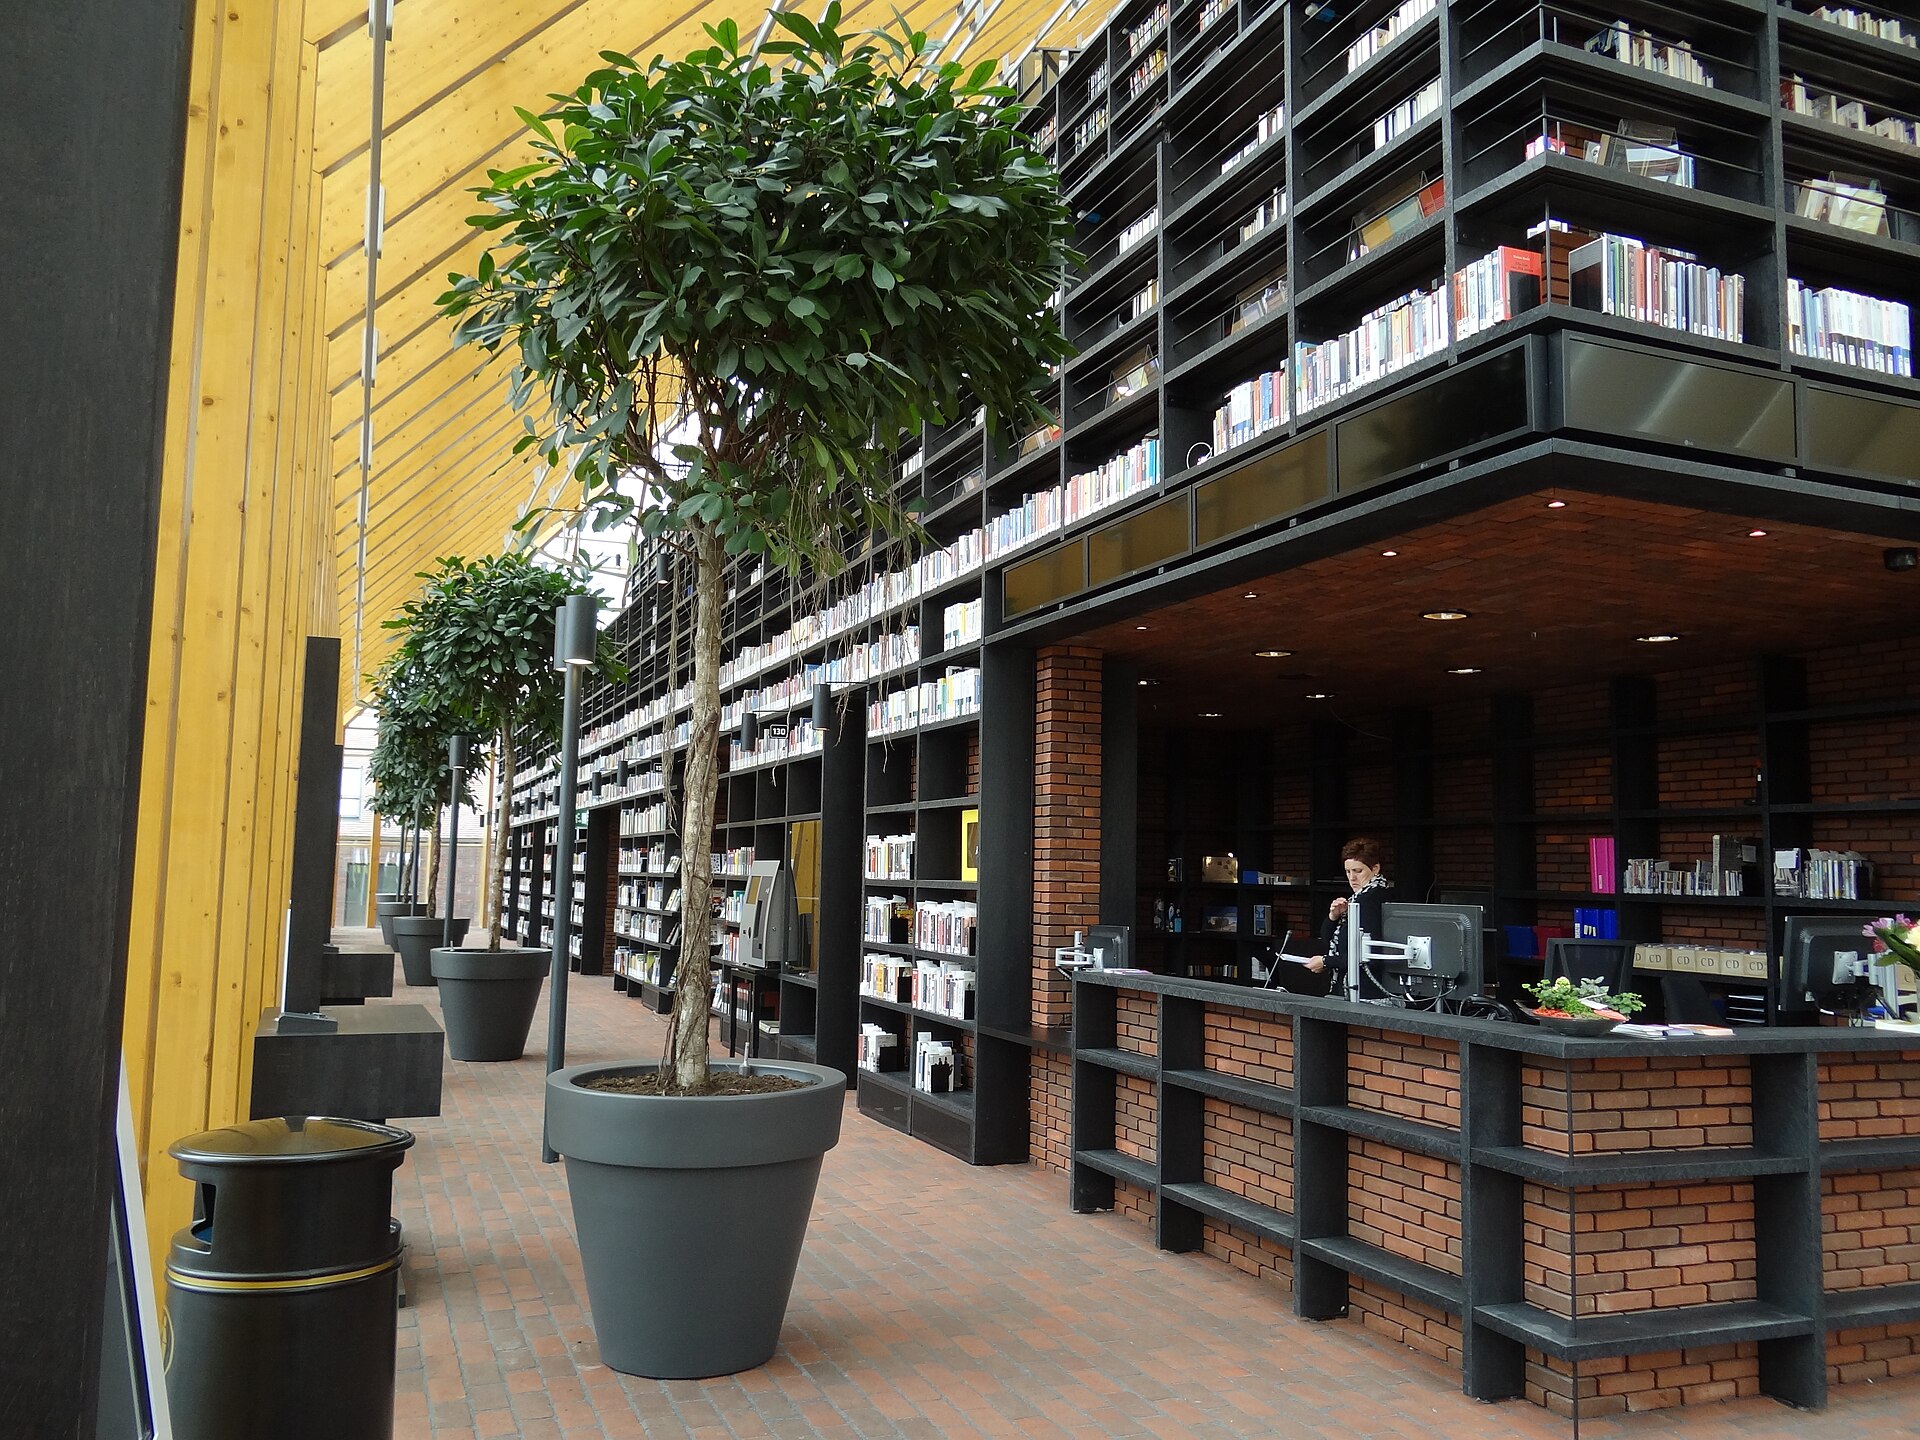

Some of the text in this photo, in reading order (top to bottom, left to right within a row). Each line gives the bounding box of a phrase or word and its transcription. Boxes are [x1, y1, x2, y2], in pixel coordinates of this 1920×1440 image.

[1648, 954, 1662, 963] CD
[1676, 955, 1690, 965] CD
[1700, 957, 1715, 967] CD
[1725, 959, 1740, 969] CD
[1749, 961, 1764, 971] CD
